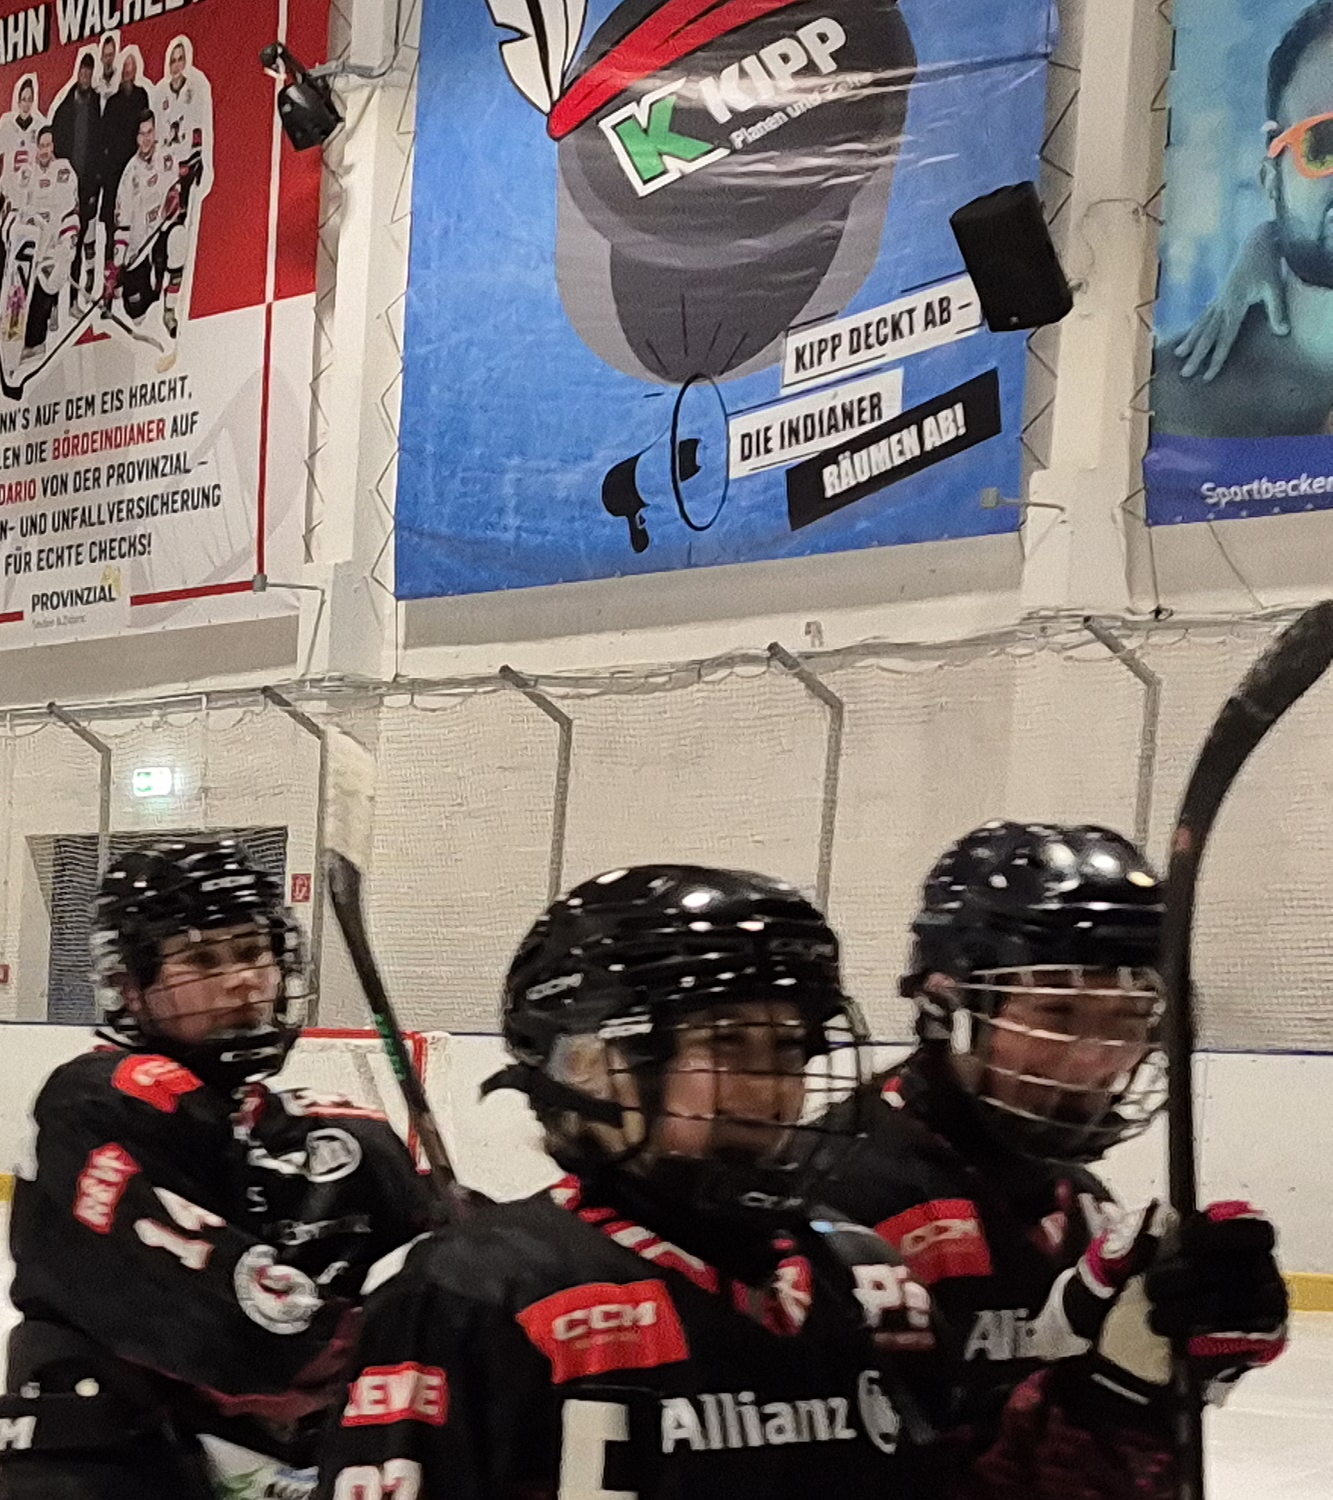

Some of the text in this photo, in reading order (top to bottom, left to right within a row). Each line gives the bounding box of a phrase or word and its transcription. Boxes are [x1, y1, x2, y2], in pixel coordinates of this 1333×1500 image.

[699, 17, 847, 124] KIPP
[731, 110, 788, 149] Planen
[794, 331, 842, 374] KIPP
[848, 306, 917, 356] DECKT
[923, 295, 952, 331] AB
[34, 404, 60, 429] AUF
[66, 394, 96, 421] DEM
[100, 388, 124, 414] EIS
[739, 391, 883, 462] DIE INDIANER
[24, 440, 48, 465] DIE
[52, 418, 166, 460] BÖRDEINDIANER
[170, 411, 199, 439] AUF
[822, 402, 967, 499] RÄUMEN AB!
[41, 471, 69, 498] VON
[73, 467, 101, 493] DER
[106, 451, 192, 486] PROVINZIAL
[20, 515, 47, 539] UND
[52, 483, 221, 532] UNFALLVERSICHERUNG
[4, 546, 32, 576] FÜR
[36, 541, 84, 571] ECHTE
[31, 584, 117, 613] PROVINZIAL
[551, 1300, 658, 1341] CCM
[660, 1390, 857, 1455] Allianz
